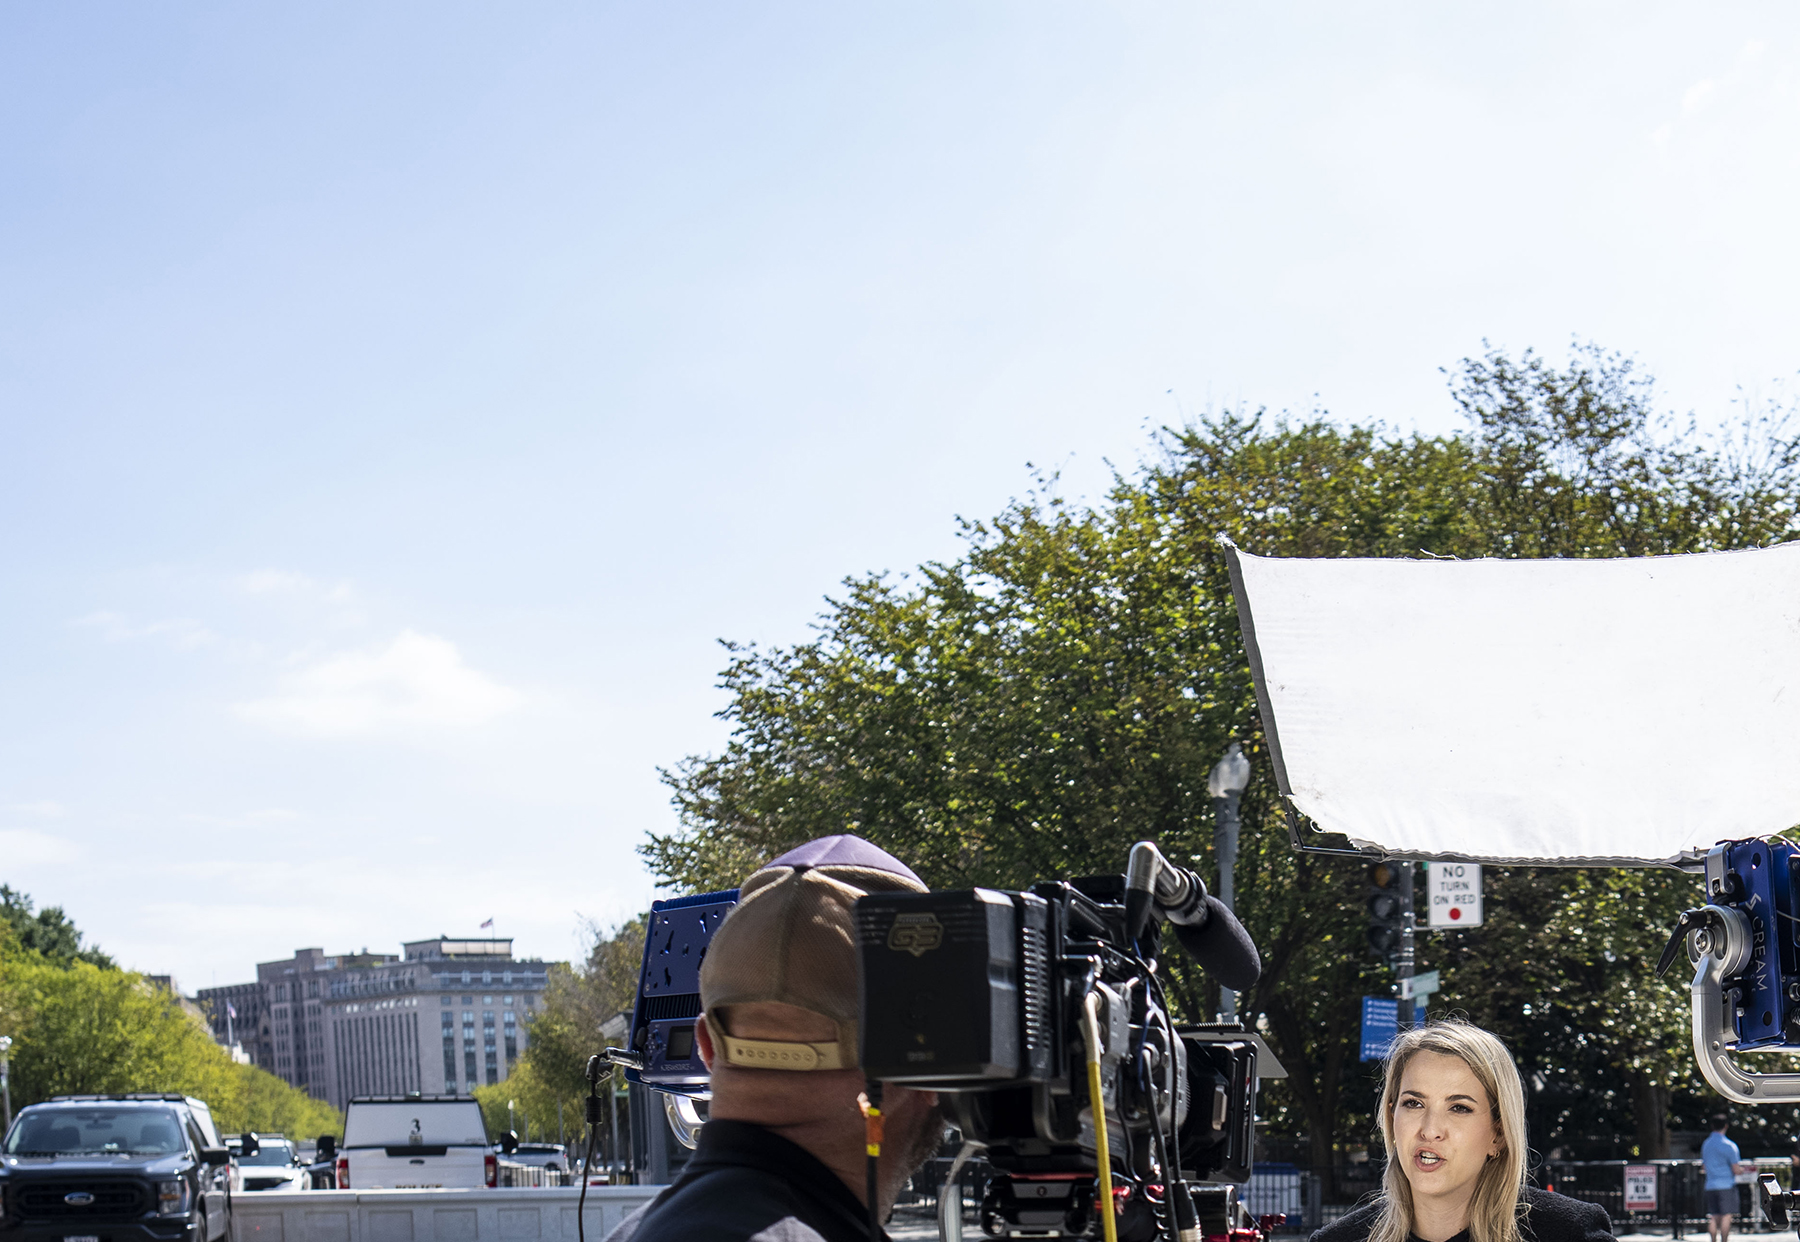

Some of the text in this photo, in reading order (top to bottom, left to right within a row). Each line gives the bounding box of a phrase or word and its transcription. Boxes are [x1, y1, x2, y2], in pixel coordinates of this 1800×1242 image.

[1443, 865, 1465, 878] NO
[1440, 881, 1469, 891] TURN
[1433, 894, 1476, 905] ON RED
[1752, 915, 1768, 991] CREAM
[410, 1118, 421, 1135] 3
